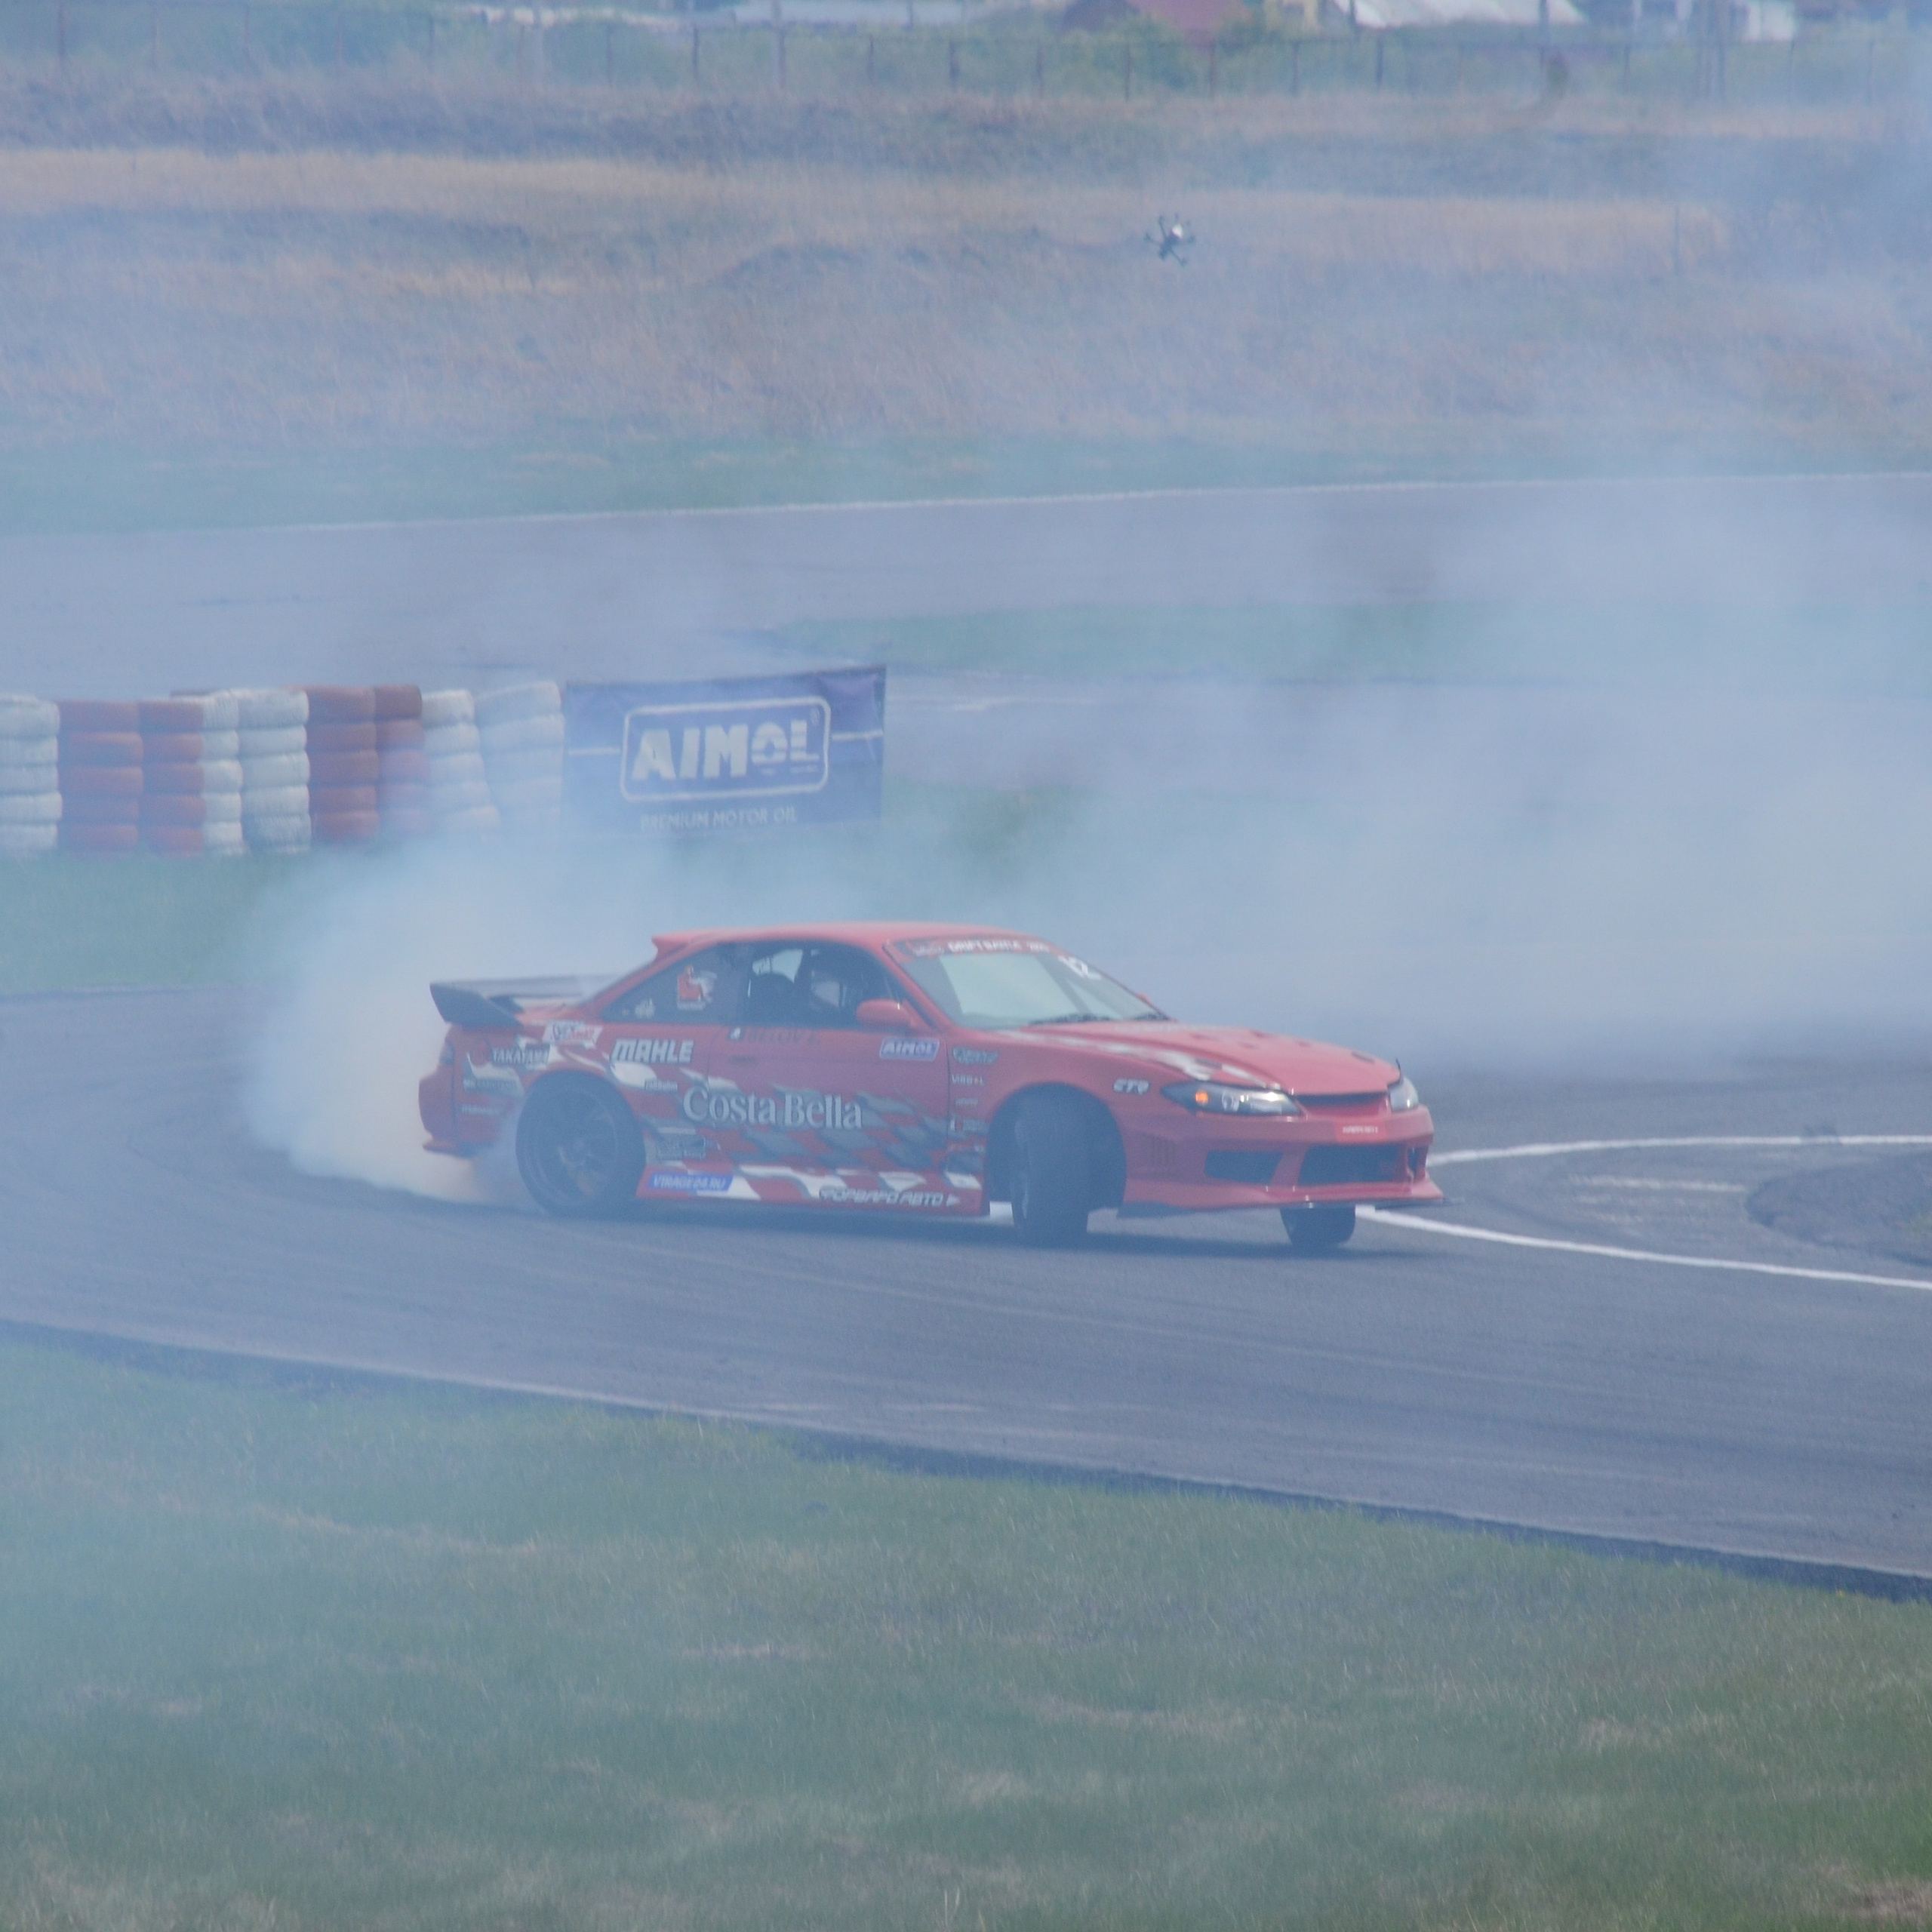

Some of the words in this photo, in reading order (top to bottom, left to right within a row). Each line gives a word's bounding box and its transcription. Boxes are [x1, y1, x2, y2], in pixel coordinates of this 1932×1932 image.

[631, 719, 820, 780] AIMOL
[641, 809, 709, 831] PREMIUM
[713, 807, 768, 828] MOTOR
[773, 804, 797, 825] OIL
[612, 1038, 694, 1063] MAHLE
[882, 1041, 935, 1055] AIMOL
[682, 1085, 777, 1127] Costa
[782, 1094, 863, 1130] Bella
